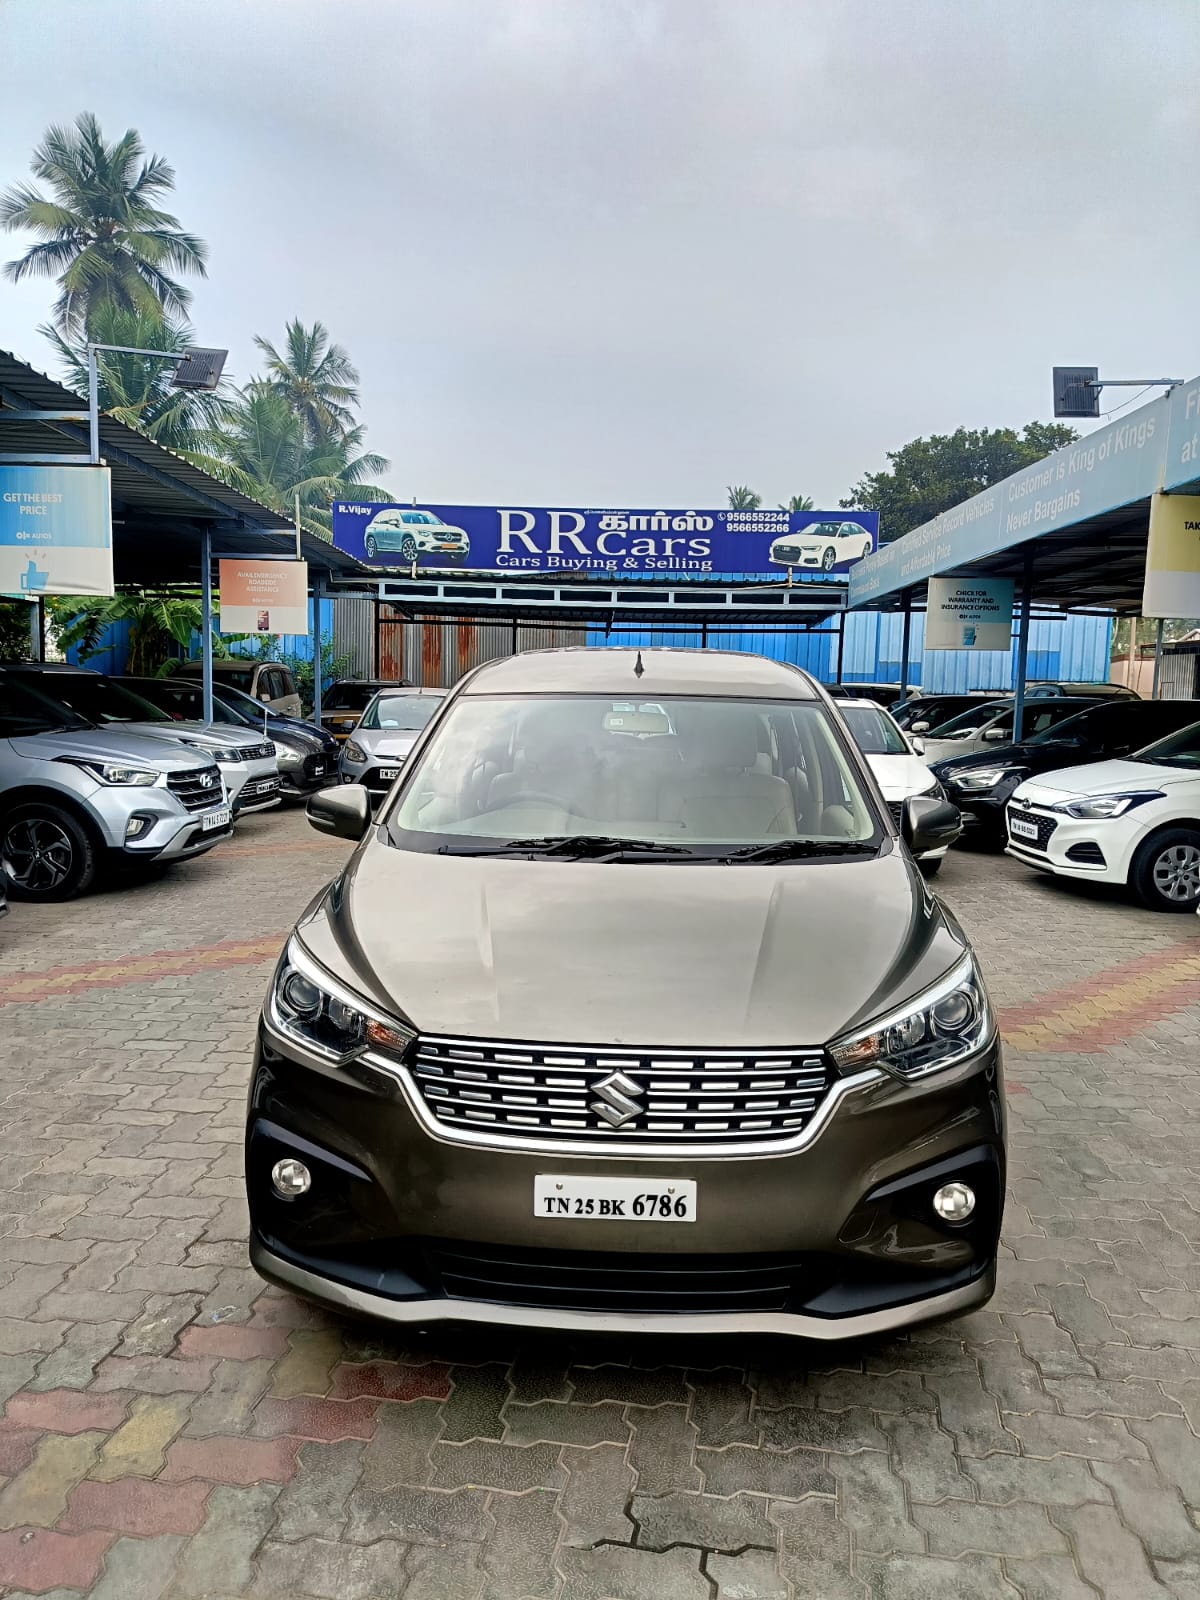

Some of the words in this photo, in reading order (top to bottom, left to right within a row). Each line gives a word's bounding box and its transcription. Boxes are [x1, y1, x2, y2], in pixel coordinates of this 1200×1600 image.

[1008, 470, 1053, 502] Customer
[1056, 459, 1065, 481] is
[1068, 449, 1095, 475] King
[1098, 433, 1112, 460] of
[1114, 416, 1156, 454] Kings
[3, 492, 21, 503] GET
[23, 492, 41, 503] THE
[42, 493, 64, 503] BEST
[20, 505, 48, 515] PRICE
[338, 504, 372, 516] R.Vijay
[726, 512, 790, 522] 9566552244
[1006, 508, 1033, 533] Never
[1035, 488, 1081, 522] Bargains
[598, 510, 714, 531] கார்ஸ்
[726, 523, 790, 533] 9566552266
[596, 531, 711, 556] Cars
[496, 554, 541, 567] Cars
[547, 556, 617, 571] Buying
[623, 557, 639, 569] &
[645, 557, 713, 572] Selling
[544, 1197, 571, 1214] TN
[575, 1198, 594, 1214] 25
[598, 1199, 625, 1215] BK
[632, 1194, 687, 1217] 6786
